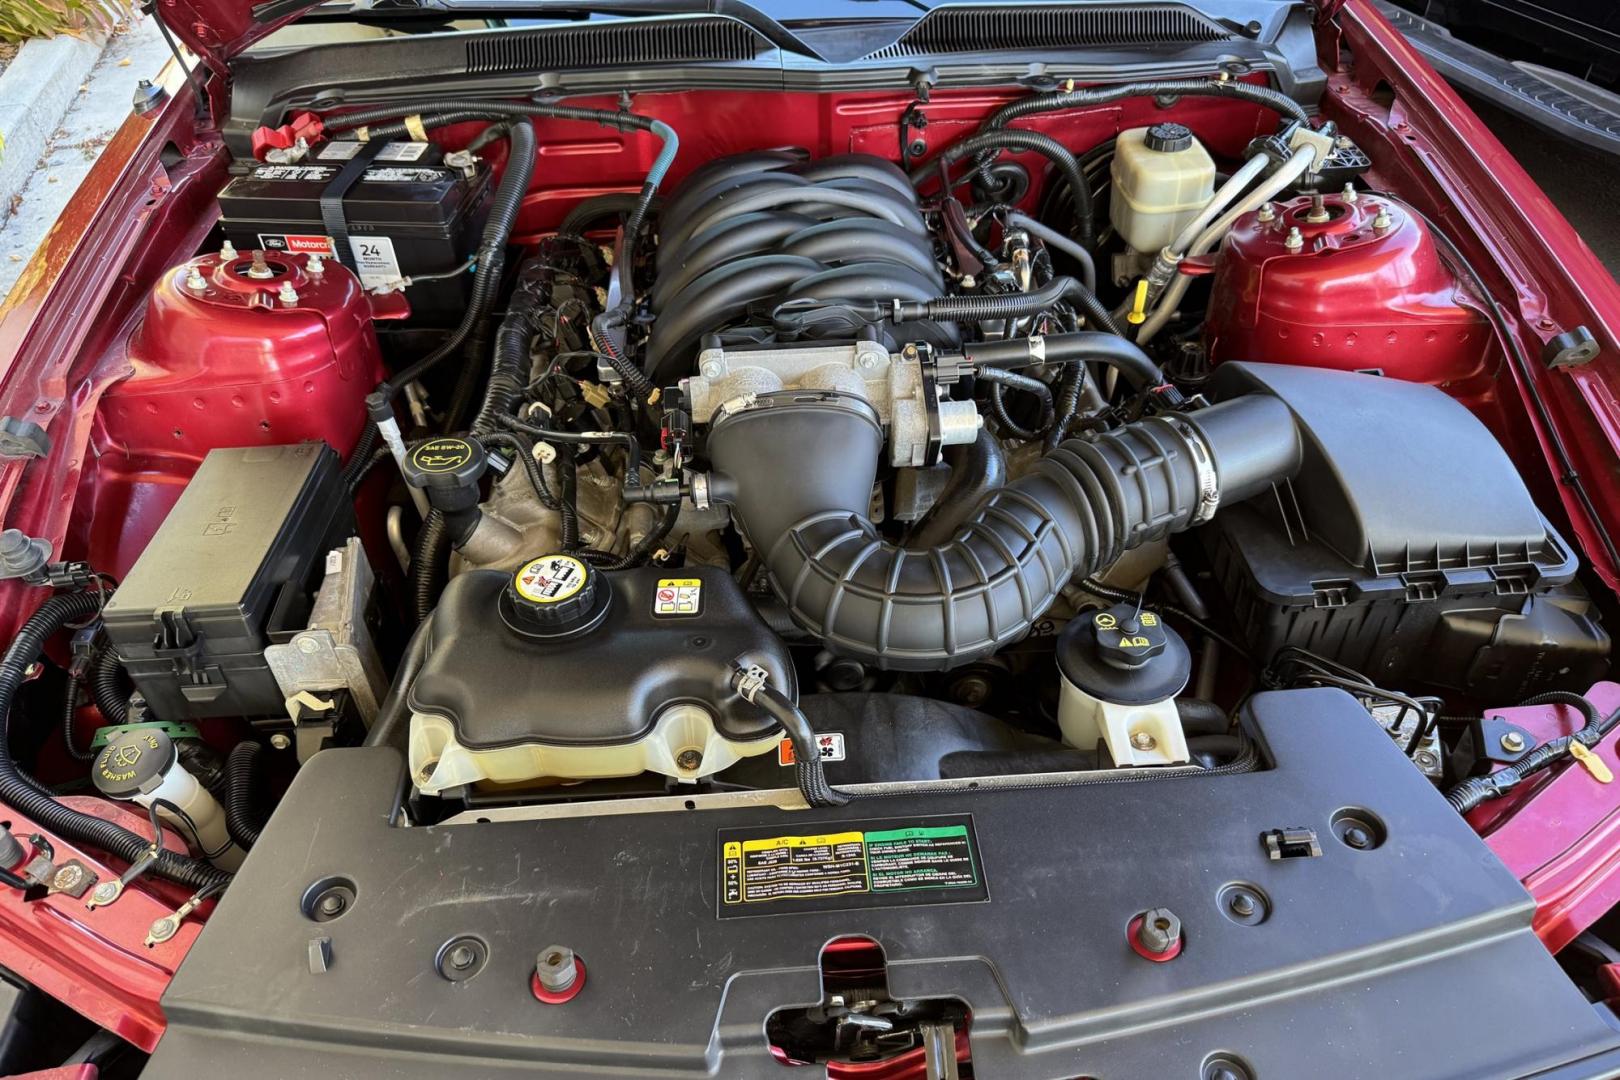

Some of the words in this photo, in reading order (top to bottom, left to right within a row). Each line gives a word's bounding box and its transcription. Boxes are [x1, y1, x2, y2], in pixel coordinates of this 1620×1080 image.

[291, 240, 331, 249] Motorcr
[359, 244, 381, 257] 24
[142, 734, 159, 749] ONLY
[100, 745, 117, 769] FLUID
[102, 769, 137, 782] WASHER
